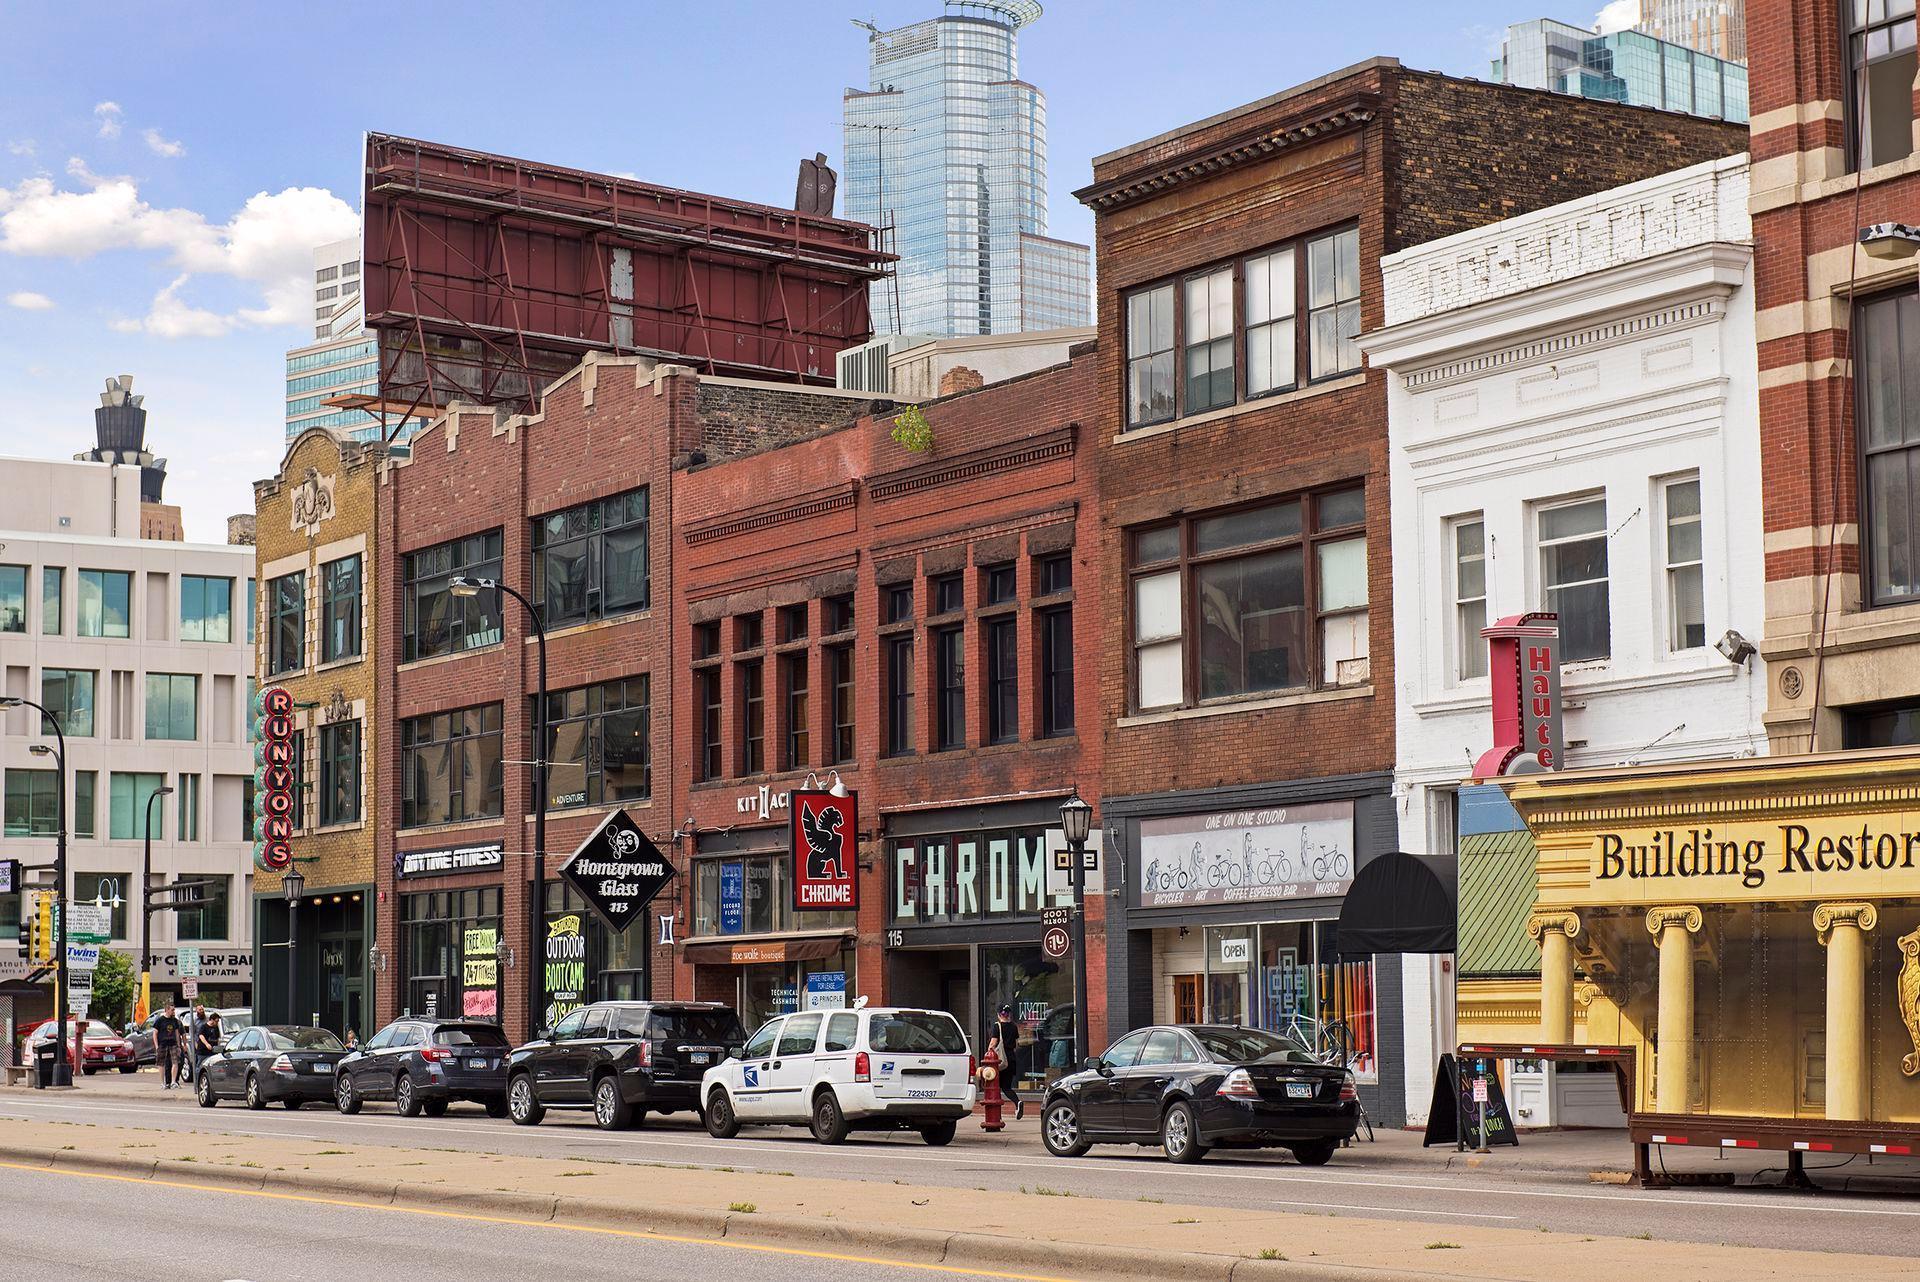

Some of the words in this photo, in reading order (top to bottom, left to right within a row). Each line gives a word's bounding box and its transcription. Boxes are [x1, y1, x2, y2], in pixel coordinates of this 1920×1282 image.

[1528, 646, 1554, 767] Haute
[271, 695, 289, 863] RUNYONS
[557, 793, 585, 804] ADVENTURE
[737, 796, 757, 813] KIT
[1206, 814, 1221, 830] ONE
[1223, 813, 1234, 827] ON
[1237, 811, 1254, 826] ONE
[1256, 809, 1287, 825] STUDIO
[403, 851, 452, 873] ANYTIME
[453, 845, 501, 868] FITNESS
[1596, 827, 1765, 888] Building
[575, 859, 664, 880] Homegrown
[897, 836, 1074, 917] CHROM
[599, 880, 639, 896] Glass
[802, 884, 850, 903] CHROME
[1153, 891, 1185, 905] BICYCLES
[1194, 889, 1208, 902] ART
[1223, 886, 1248, 901] COFFEE
[1249, 884, 1282, 899] ESPRESSO
[1283, 884, 1298, 896] BAR
[1314, 881, 1340, 895] MUSIC
[609, 902, 629, 913] 113
[1043, 910, 1067, 919] LOOP
[466, 933, 479, 951] FREE
[888, 930, 903, 947] 115
[67, 947, 98, 958] Twins
[546, 936, 584, 959] OUTDOOR
[761, 950, 784, 961] boutique
[1223, 944, 1246, 958] OPEN
[165, 955, 224, 966] CURY
[205, 968, 238, 976] UP/ATM
[908, 1090, 937, 1098] 7224337
